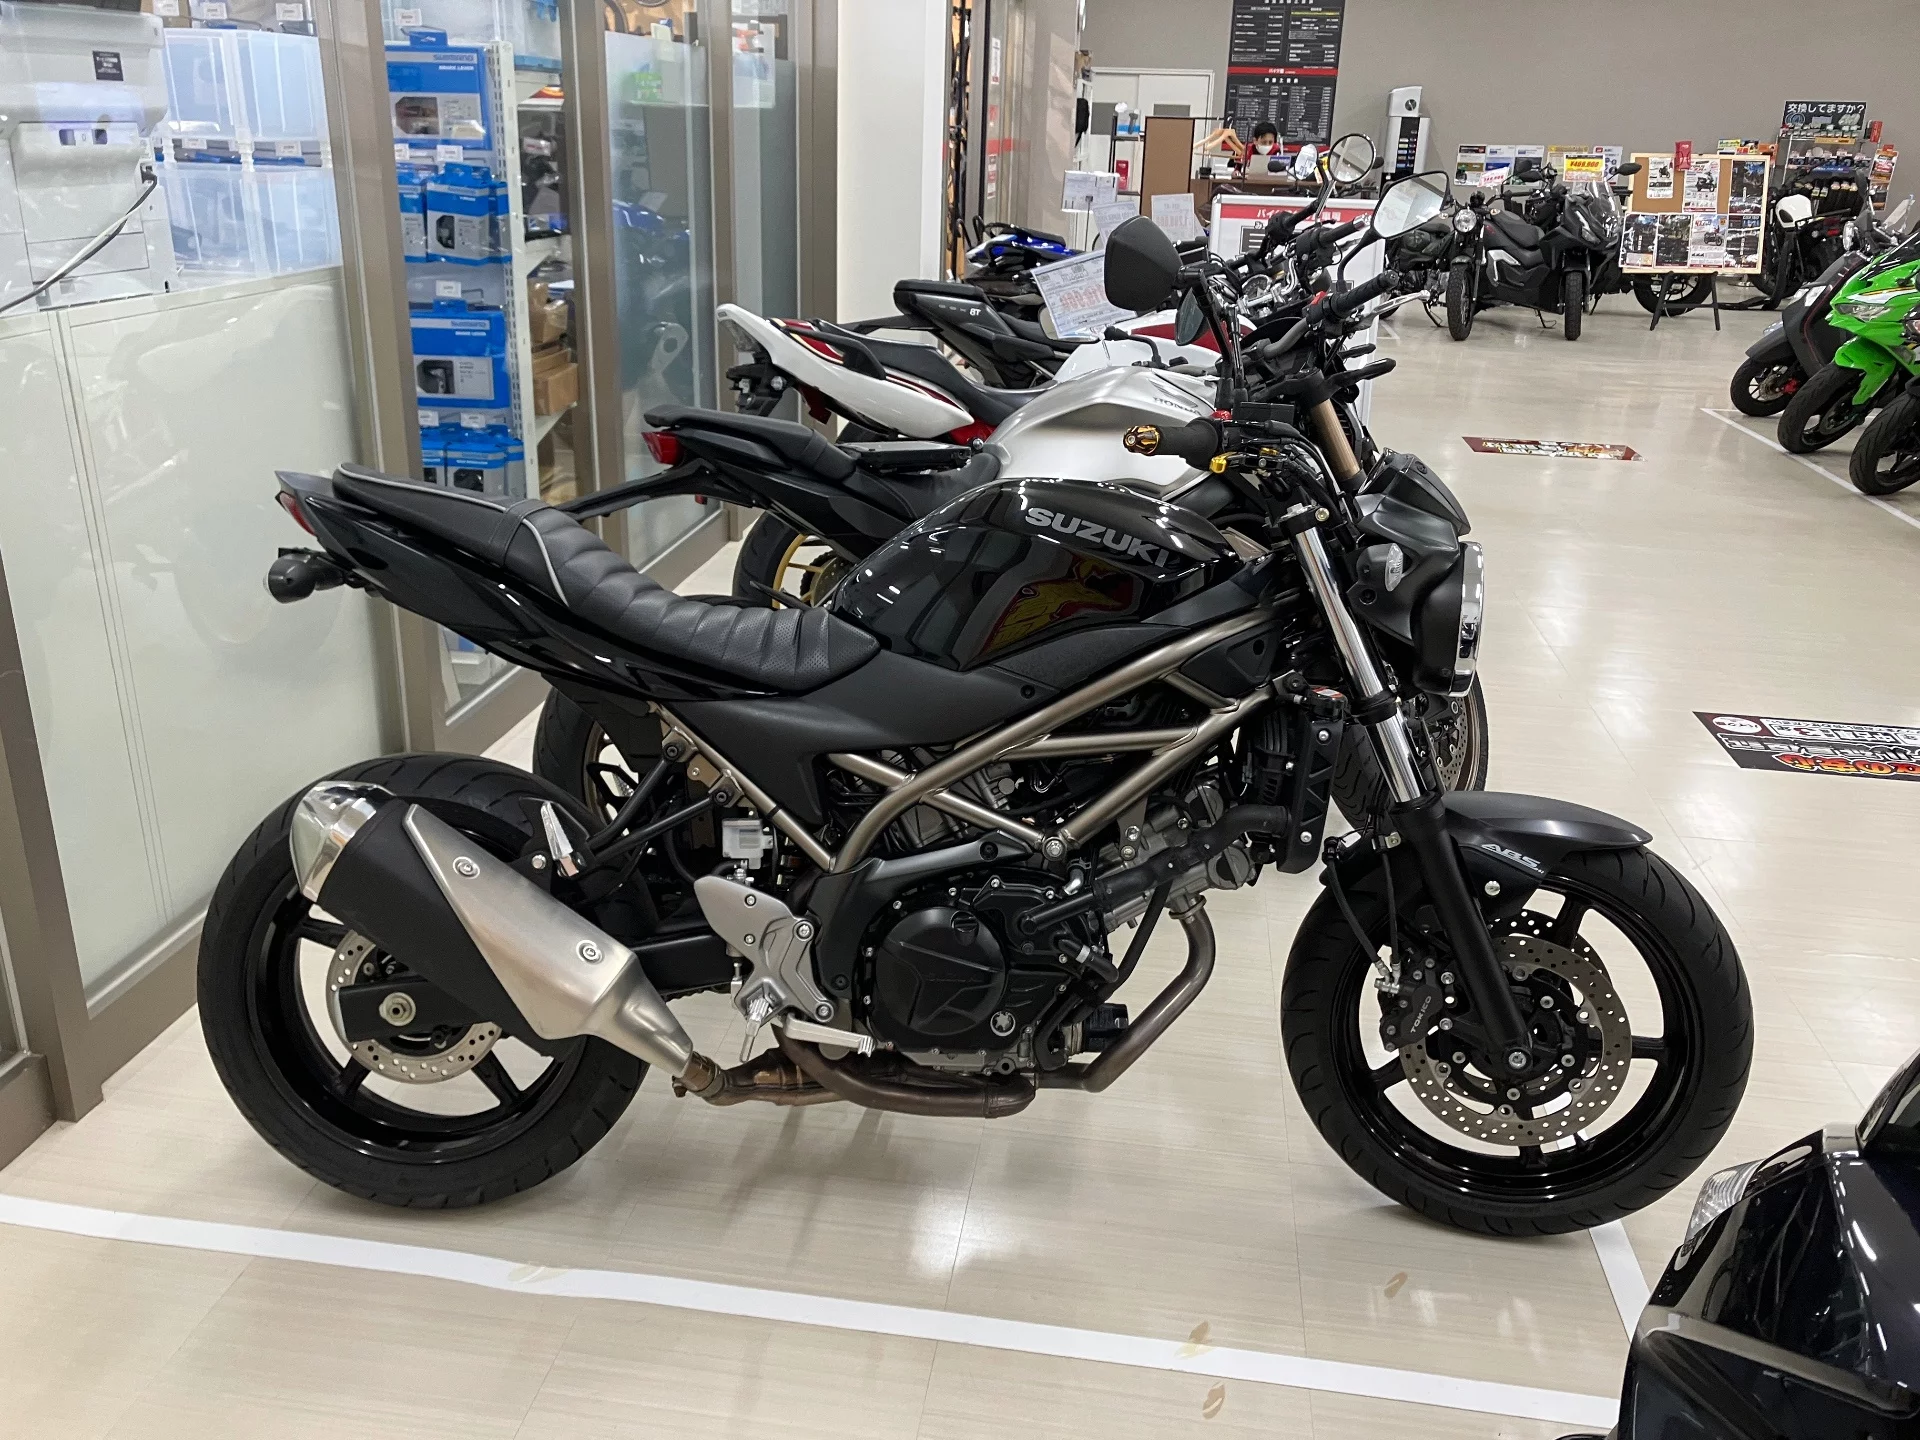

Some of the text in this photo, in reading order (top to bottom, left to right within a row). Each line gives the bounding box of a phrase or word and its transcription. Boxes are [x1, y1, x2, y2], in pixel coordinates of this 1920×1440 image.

[1025, 507, 1170, 568] SUZUKI
[1481, 844, 1541, 870] ABS
[1410, 995, 1432, 1033] TOKICO
